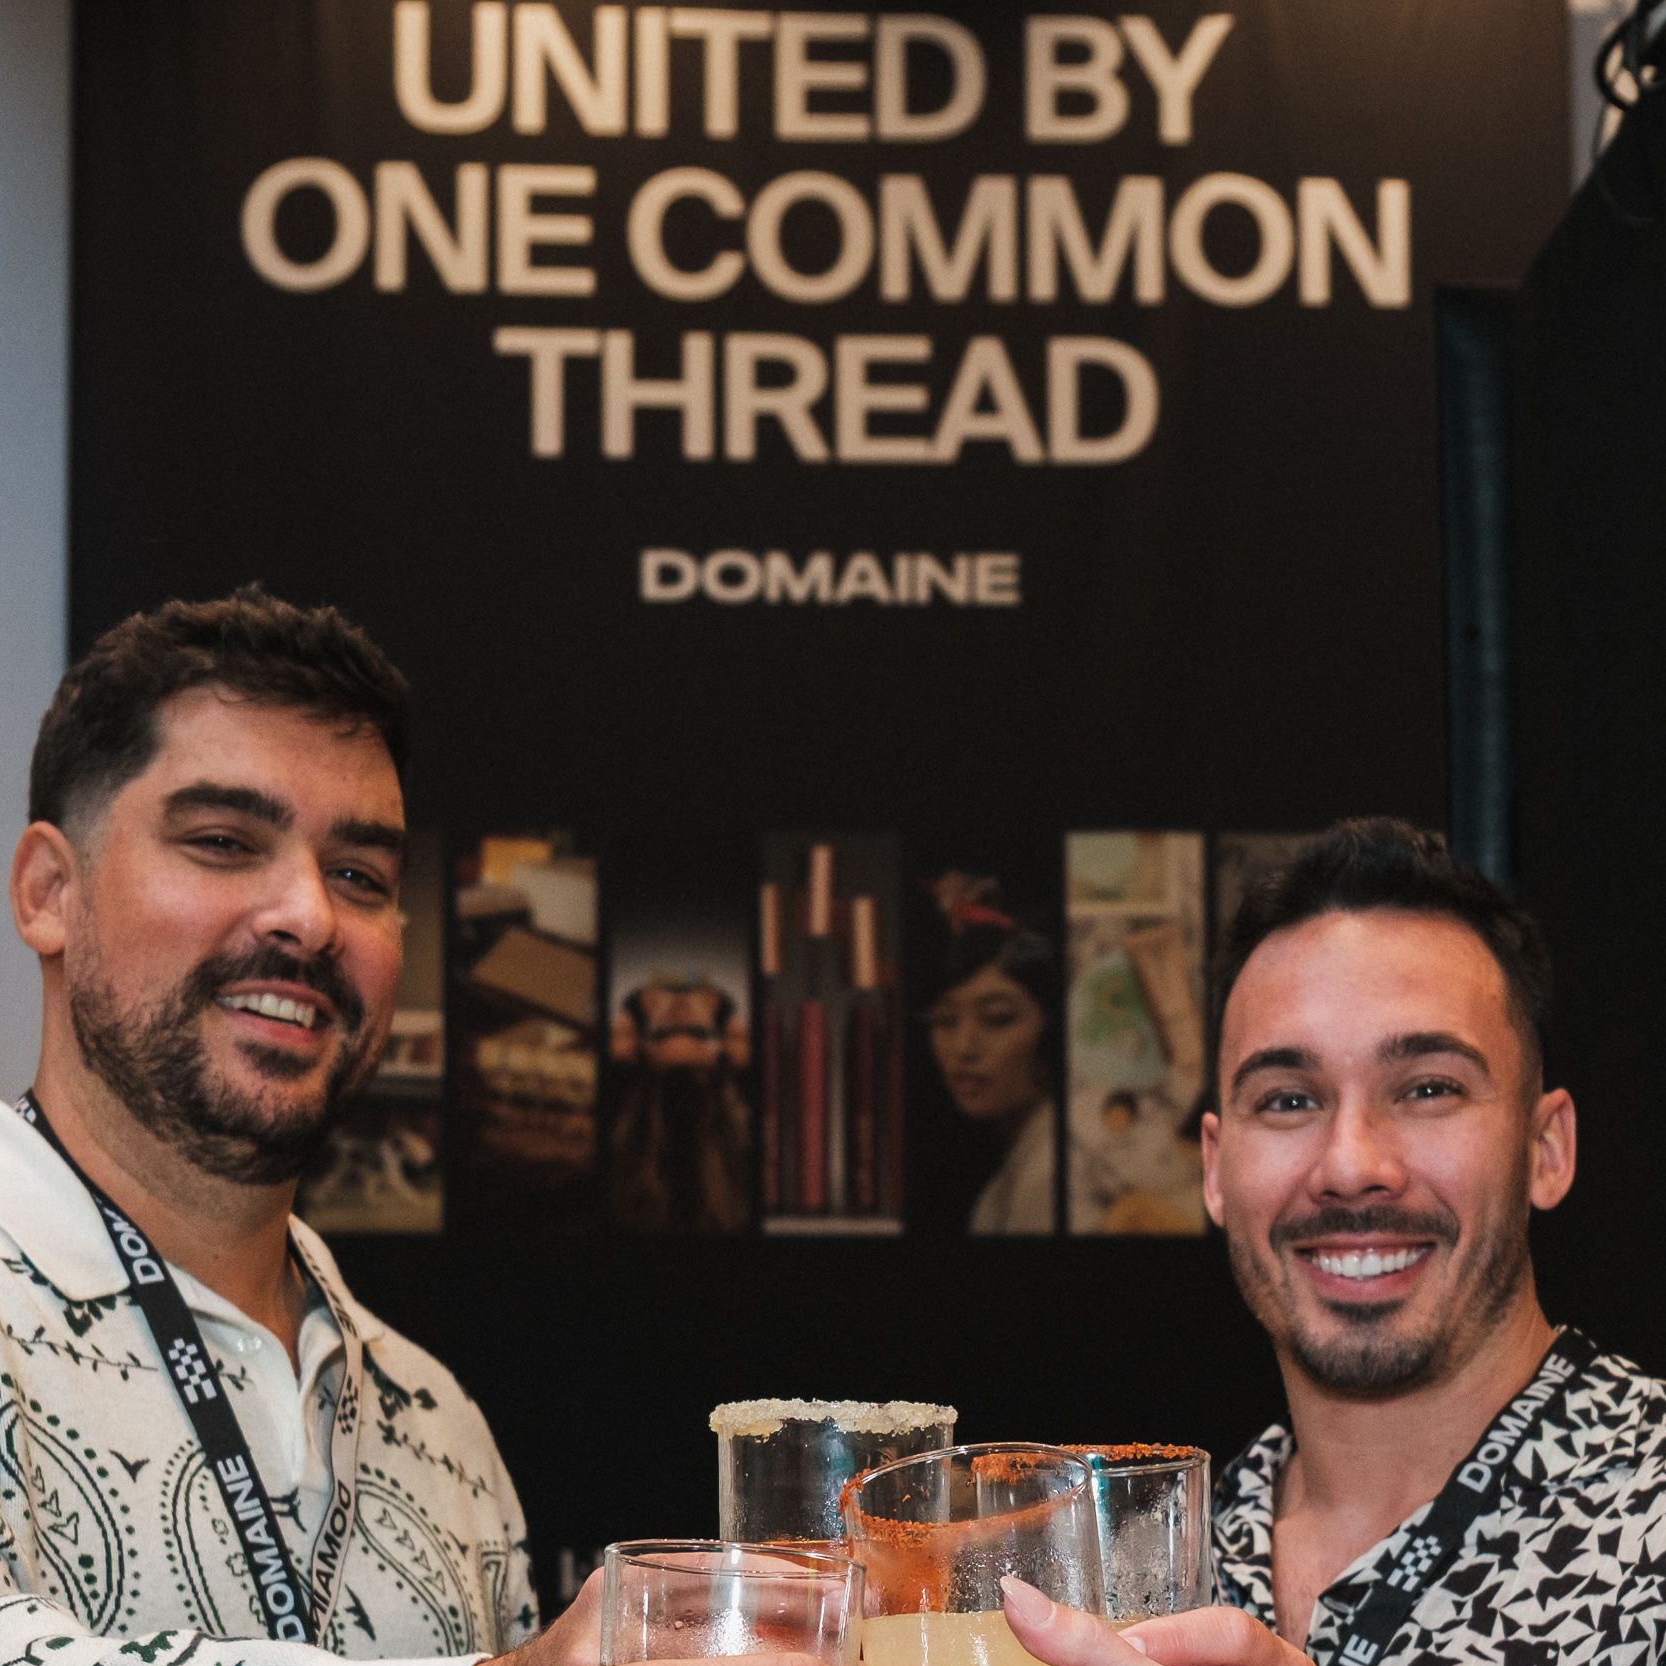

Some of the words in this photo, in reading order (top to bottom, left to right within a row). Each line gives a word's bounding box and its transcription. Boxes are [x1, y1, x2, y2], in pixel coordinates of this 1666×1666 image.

[392, 0, 985, 141] UNITED
[1025, 12, 1234, 144] BY
[241, 157, 598, 296] ONE
[626, 166, 1411, 308] COMMON
[493, 327, 1159, 464] THREAD
[639, 549, 1020, 604] DOMAINE
[1456, 1353, 1577, 1495] DOMAINE
[216, 1454, 307, 1642] DOMAINE
